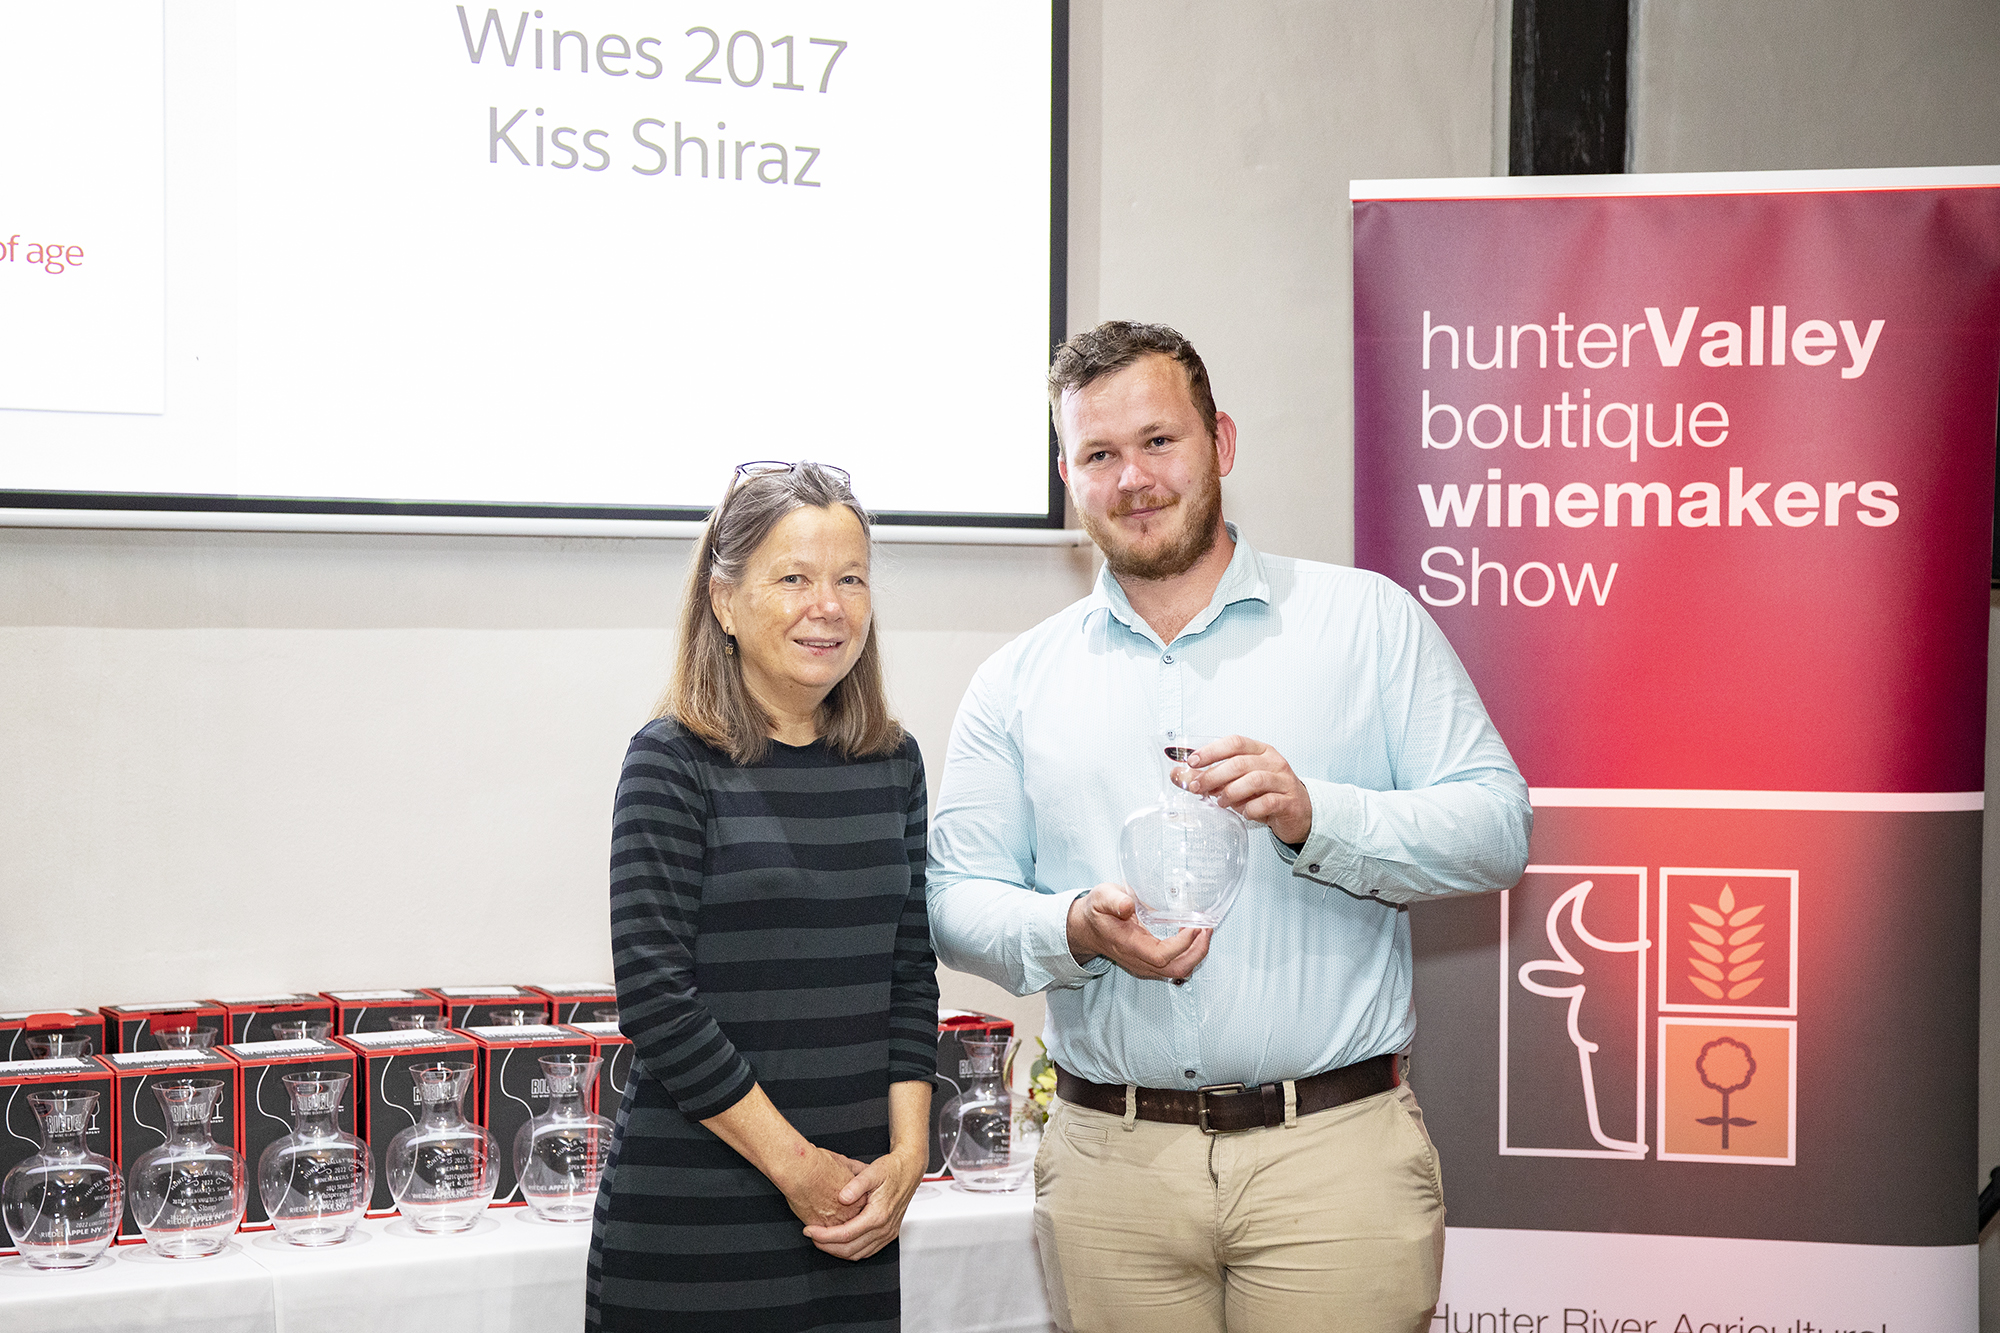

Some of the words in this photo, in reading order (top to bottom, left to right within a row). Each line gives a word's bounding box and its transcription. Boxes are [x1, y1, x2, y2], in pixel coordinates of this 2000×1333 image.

[456, 5, 663, 80] Wines
[685, 26, 848, 93] 2017
[490, 107, 611, 172] Kiss
[632, 118, 821, 188] Shiraz
[27, 243, 84, 275] age
[1422, 306, 1886, 379] hunterValley
[1422, 389, 1730, 463] boutique
[1418, 468, 1900, 528] winemakers
[1418, 546, 1619, 608] Show
[85, 1179, 103, 1198] HUNTER
[1564, 1308, 1658, 1333] River
